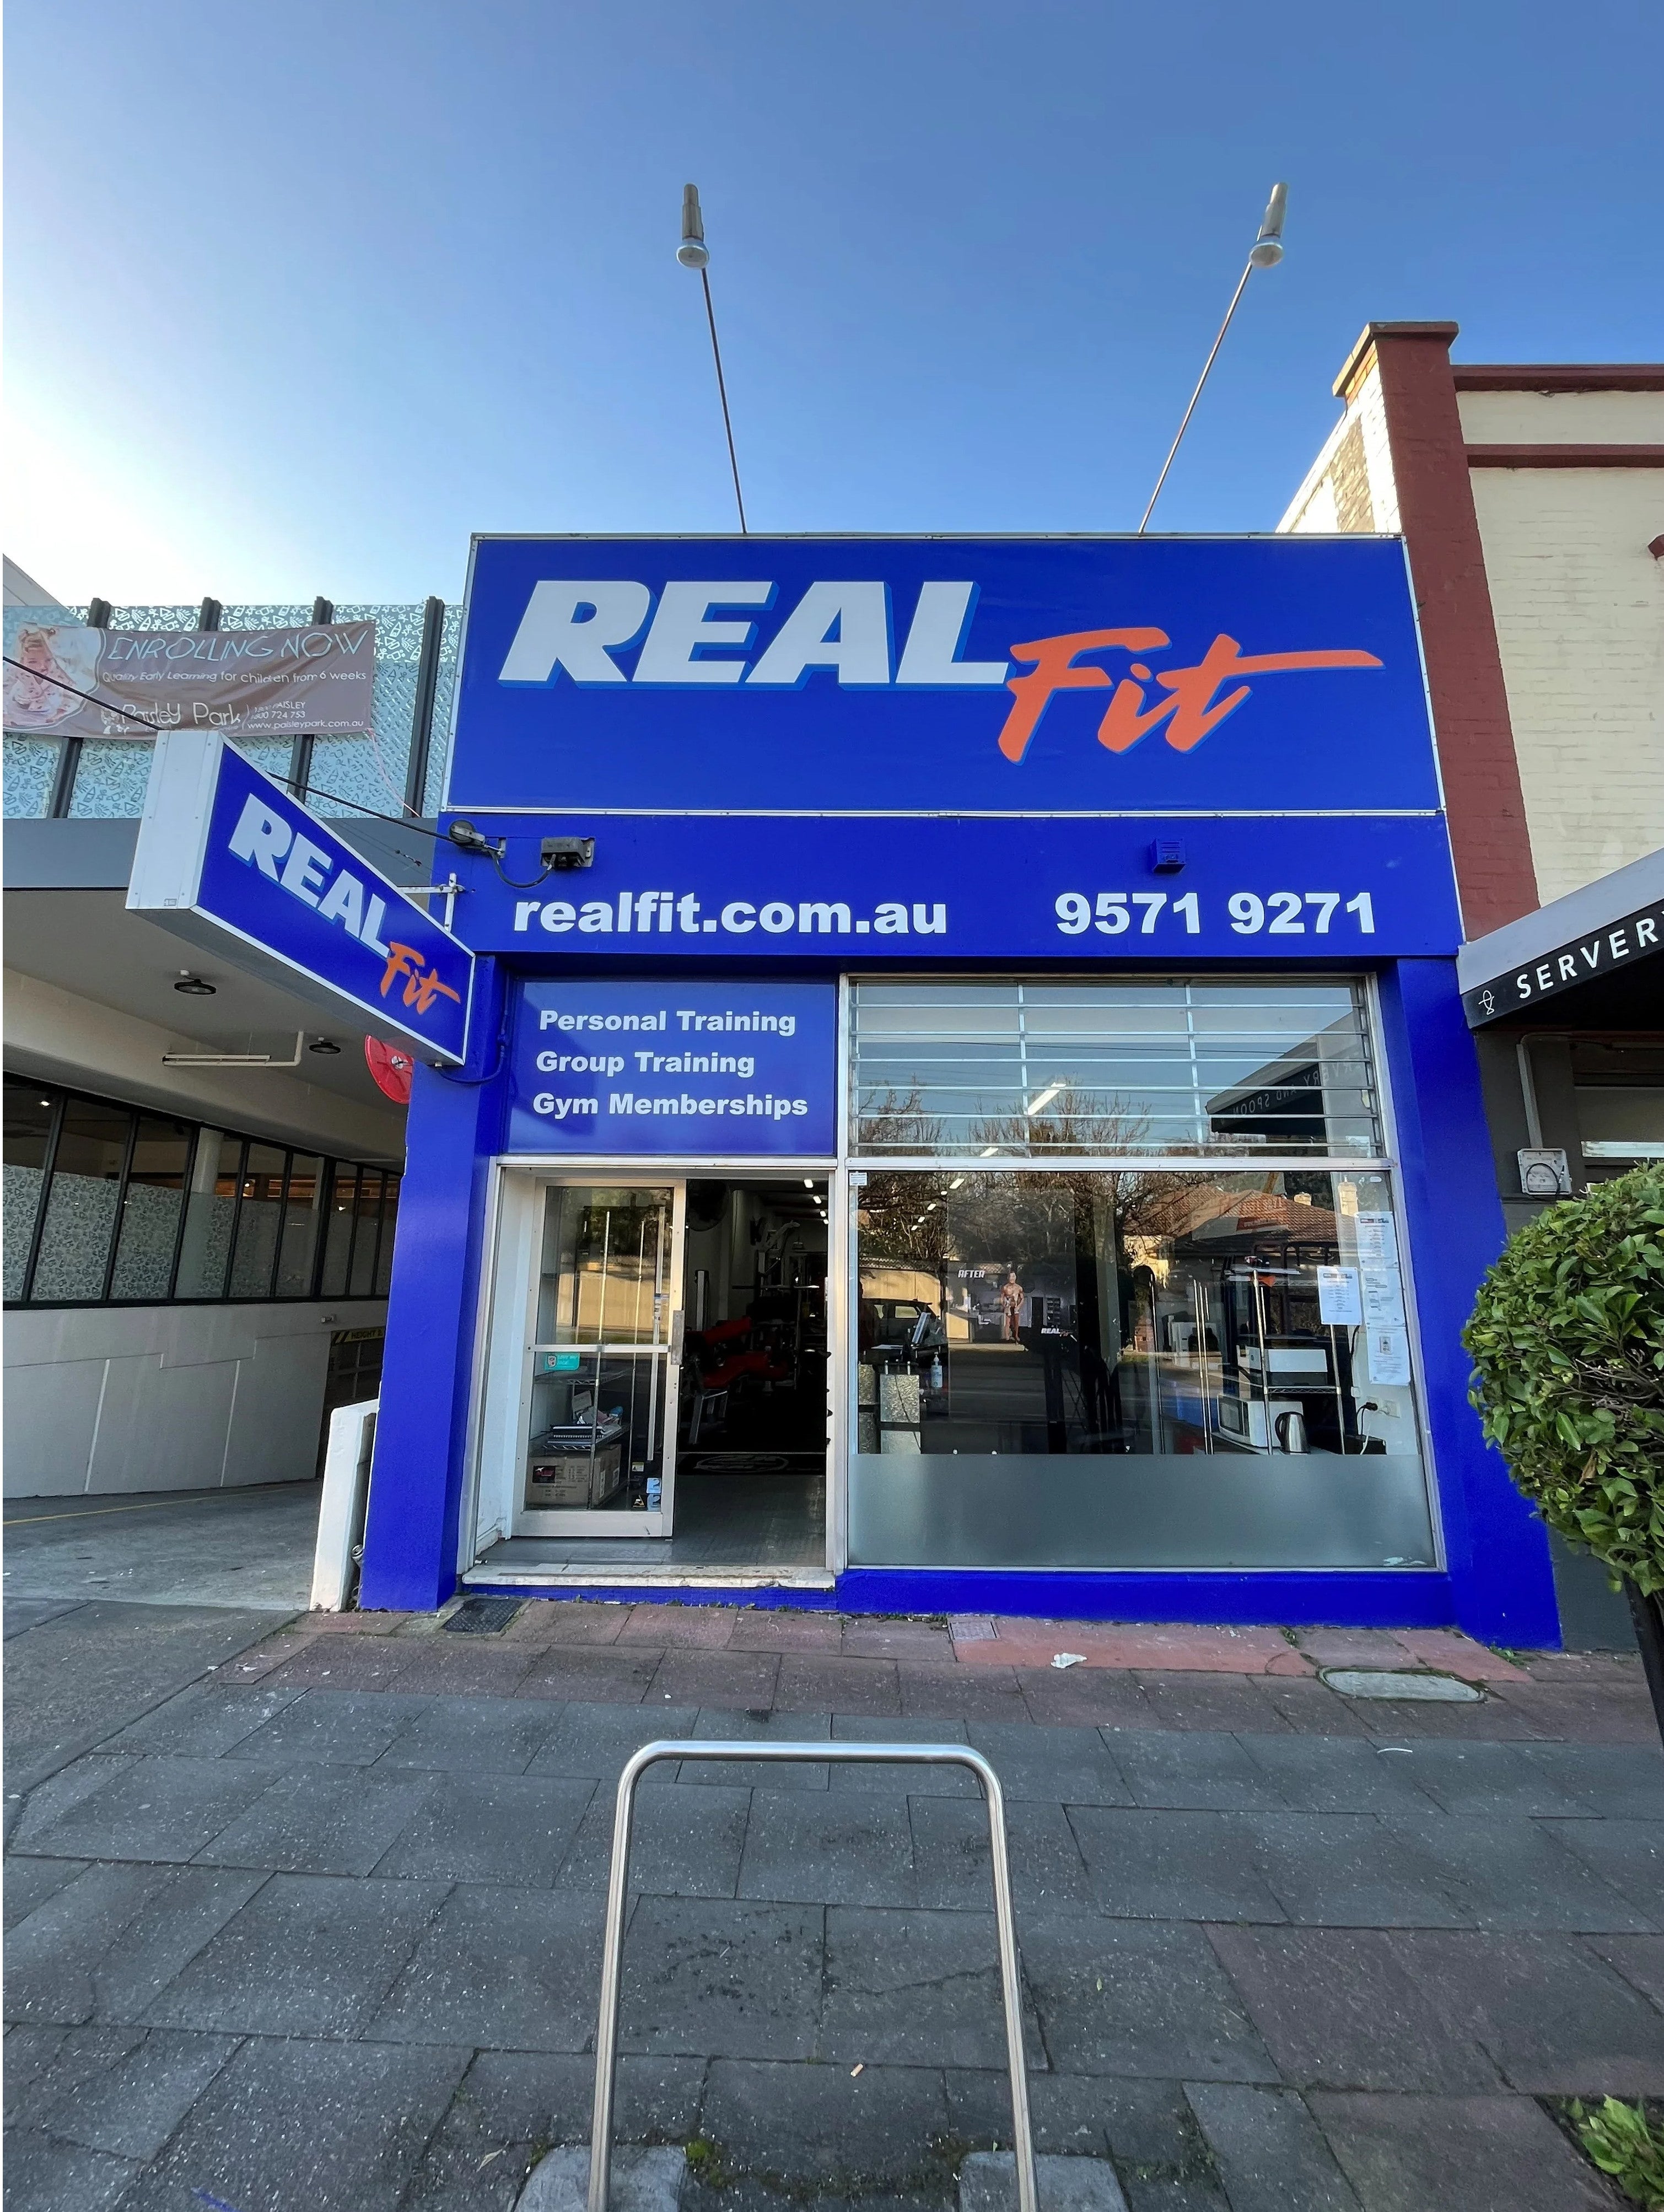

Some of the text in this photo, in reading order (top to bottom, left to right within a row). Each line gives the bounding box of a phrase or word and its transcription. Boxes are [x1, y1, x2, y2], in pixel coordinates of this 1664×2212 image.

[107, 629, 369, 661] ENROLLING NOW
[139, 671, 164, 681] Early
[167, 671, 217, 682] Learning
[220, 671, 237, 681] for
[240, 673, 289, 683] children
[293, 673, 317, 683] from
[319, 670, 326, 680] 6
[330, 671, 367, 680] weeks
[498, 580, 1385, 765] REAL Fit
[122, 702, 241, 725] Paisley Park
[247, 719, 364, 730] www.paisleypark.com.au
[271, 711, 288, 719] 724
[290, 710, 306, 718] 753
[228, 793, 461, 1015] REAL Fit
[513, 891, 947, 934] realfit.com.au
[1054, 892, 1376, 934] 9571 9271
[539, 1010, 796, 1037] Personal Training
[536, 1051, 755, 1078] Group Training
[532, 1092, 808, 1121] Gym Memberships
[957, 1269, 986, 1278] AFTER
